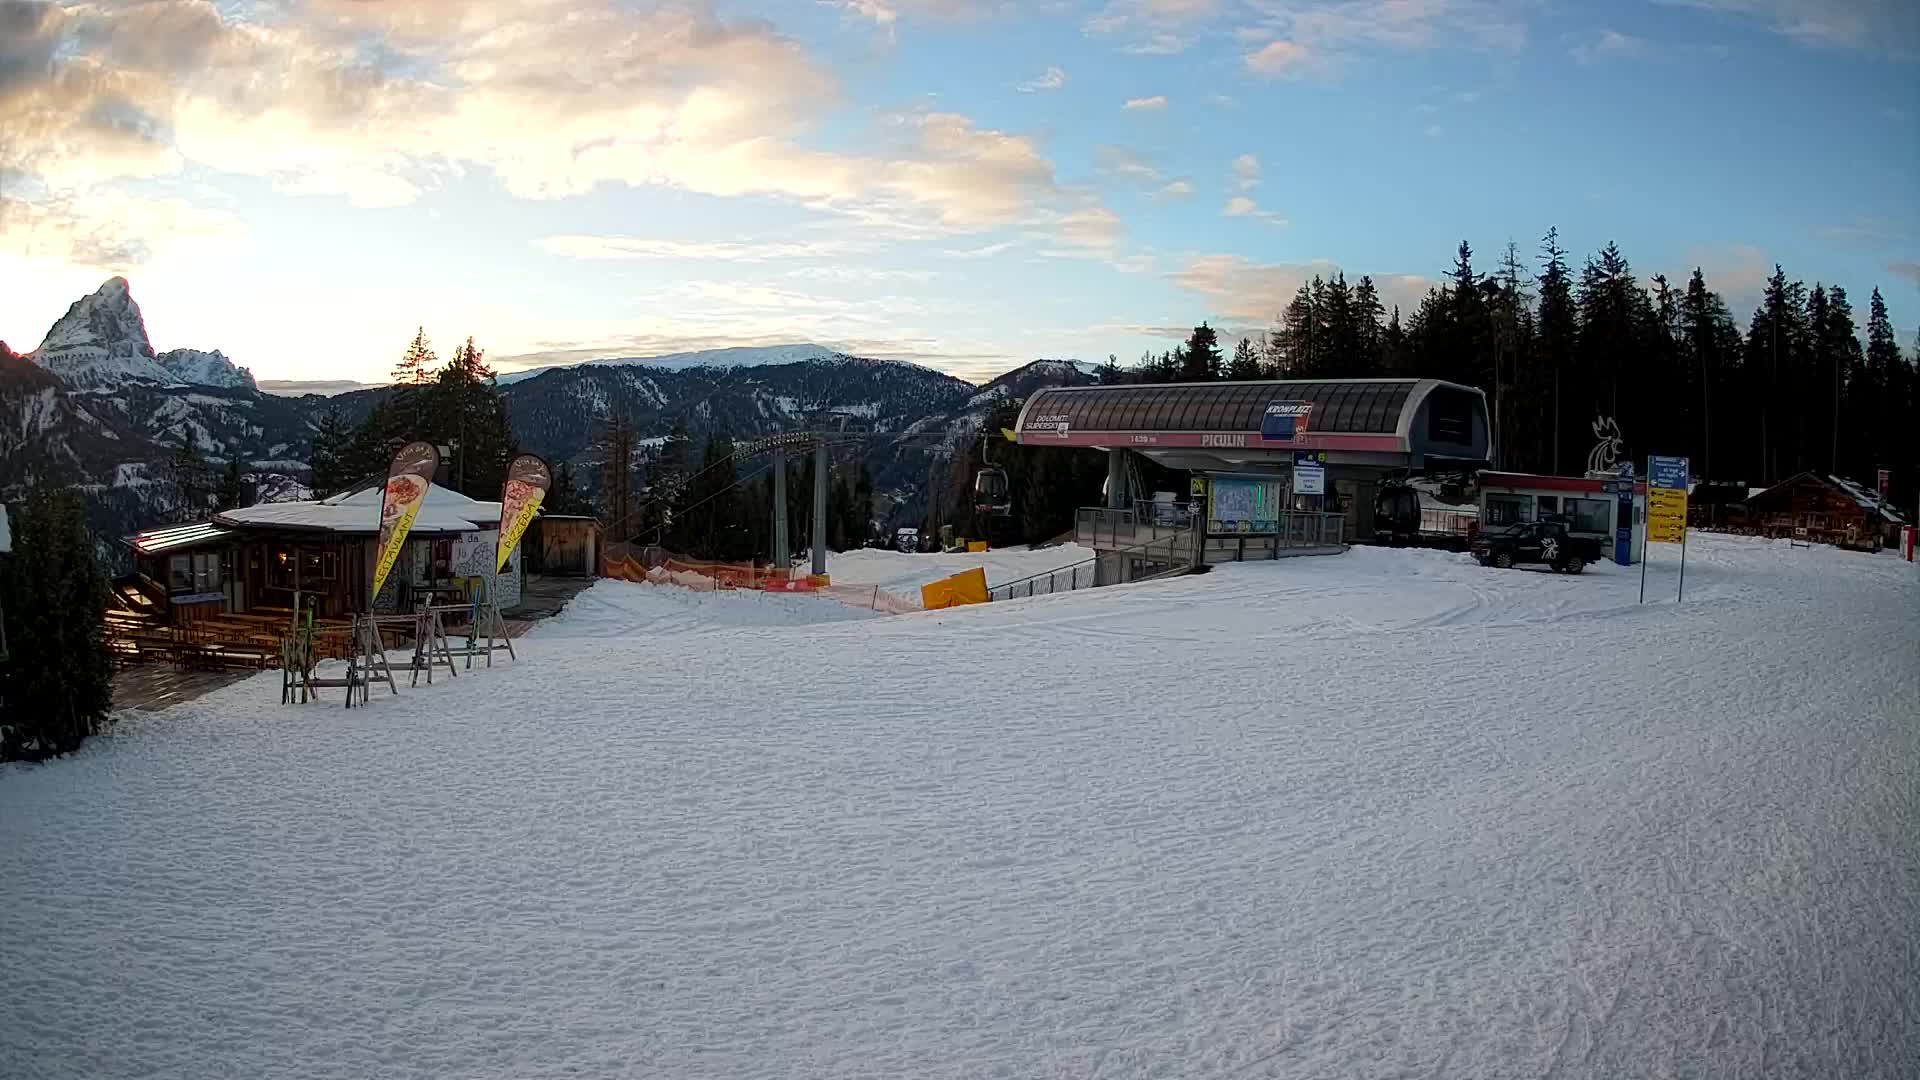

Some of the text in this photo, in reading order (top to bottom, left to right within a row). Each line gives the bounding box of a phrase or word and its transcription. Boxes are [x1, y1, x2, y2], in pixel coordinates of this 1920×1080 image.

[1266, 405, 1312, 413] KRONPLATZ
[1024, 422, 1058, 430] SUPERSKI
[1202, 434, 1245, 447] PICULIN
[504, 503, 536, 549] PIZZERIA
[376, 511, 412, 584] RESTAURANT
